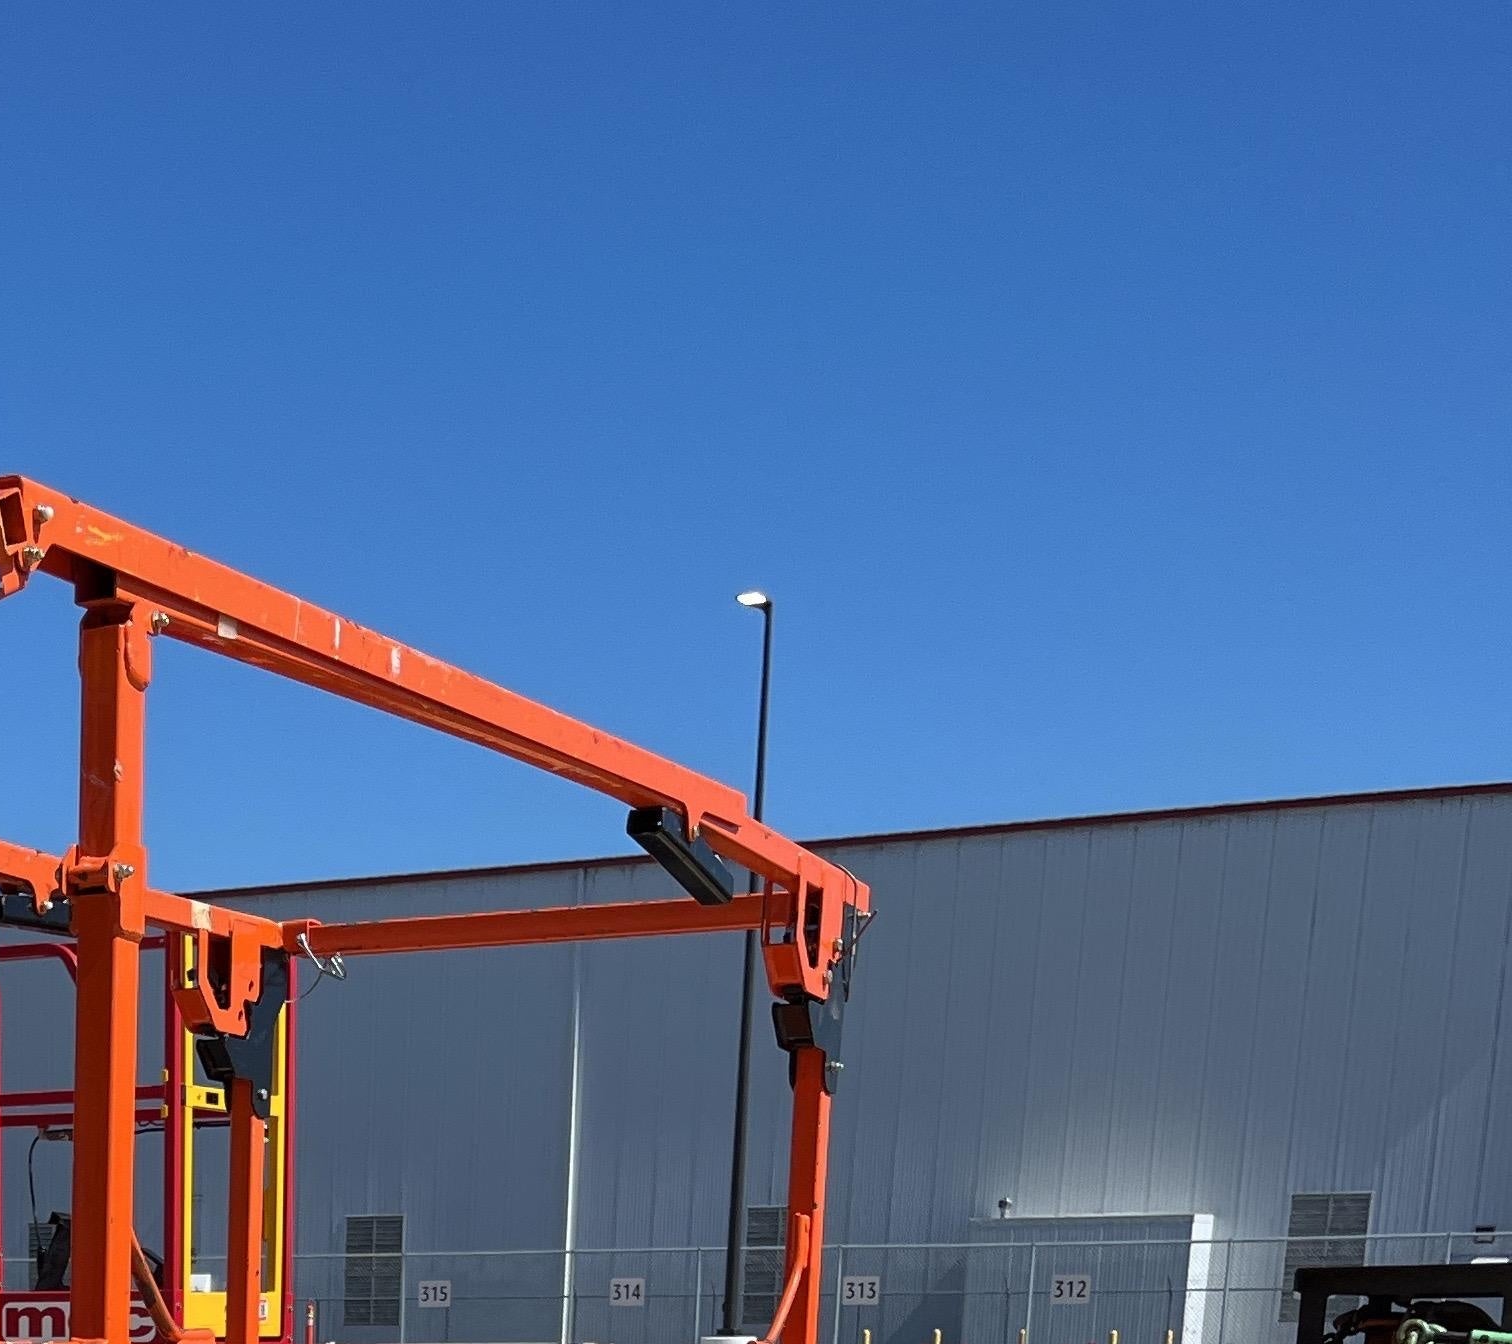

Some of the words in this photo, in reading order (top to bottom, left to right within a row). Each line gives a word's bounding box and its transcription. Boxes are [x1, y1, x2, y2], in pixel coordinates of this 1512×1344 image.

[421, 1286, 448, 1302] 315
[613, 1284, 640, 1300] 314
[846, 1282, 877, 1299] 313
[1054, 1280, 1087, 1298] 312
[6, 1306, 154, 1339] mc
